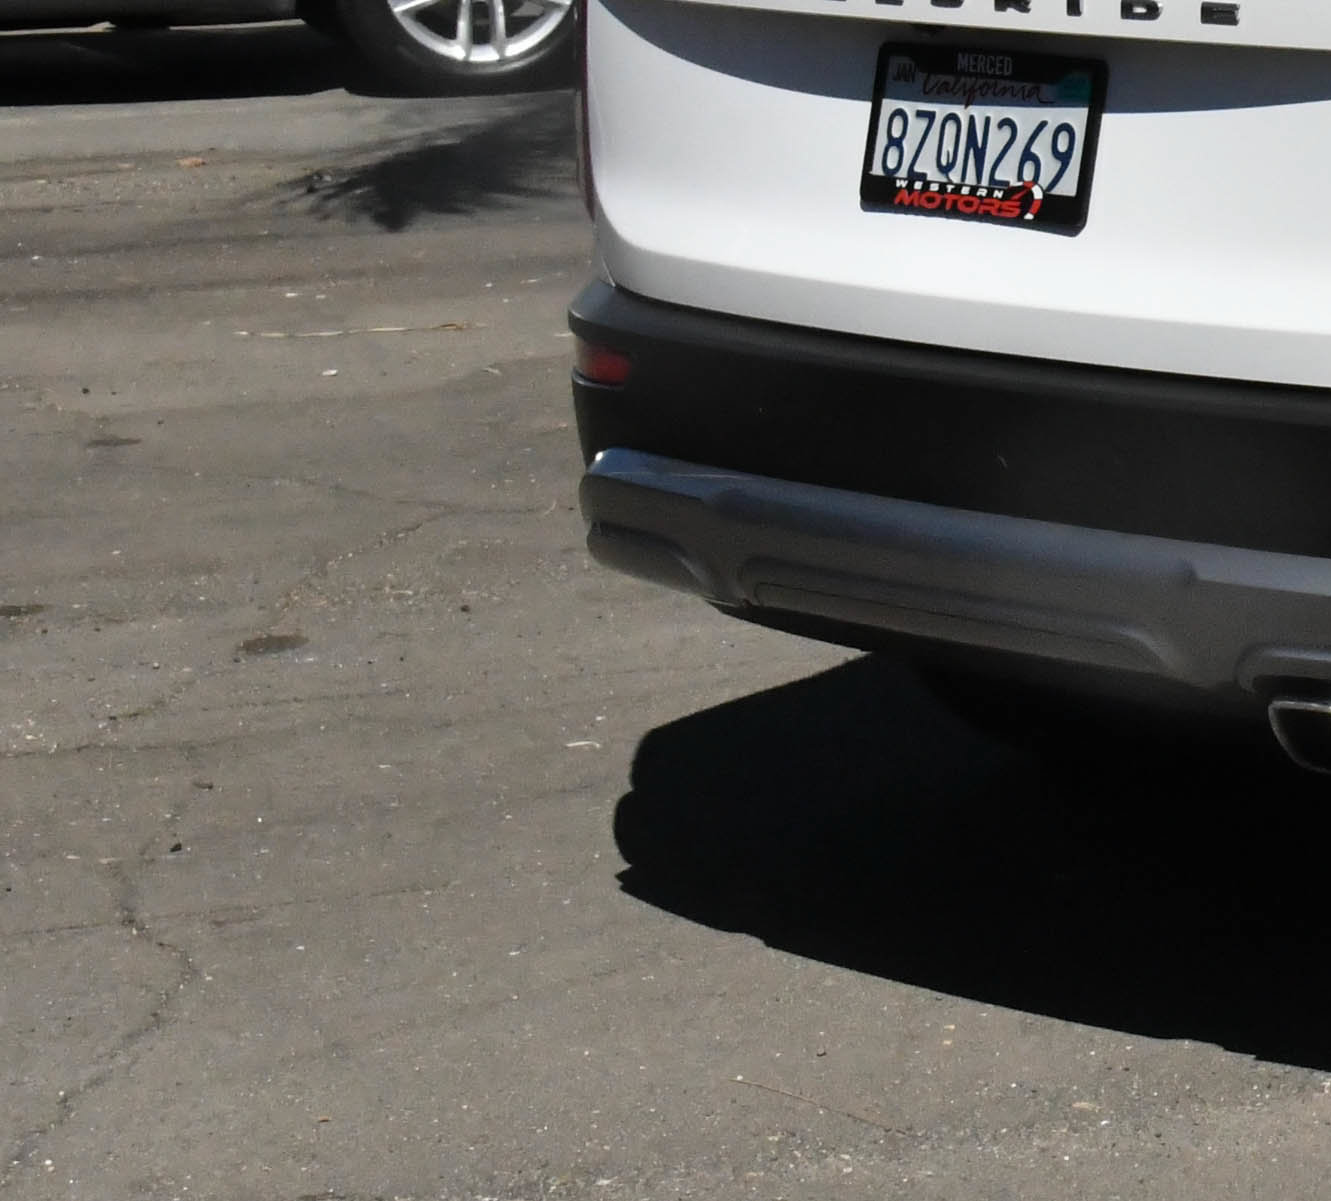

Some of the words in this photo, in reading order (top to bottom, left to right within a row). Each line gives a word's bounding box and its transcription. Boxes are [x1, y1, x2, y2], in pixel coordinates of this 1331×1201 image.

[957, 52, 1013, 75] MERCED
[881, 107, 1076, 194] 8ZQN269
[895, 179, 1004, 199] WESTERN
[894, 189, 1022, 218] MOTORS
